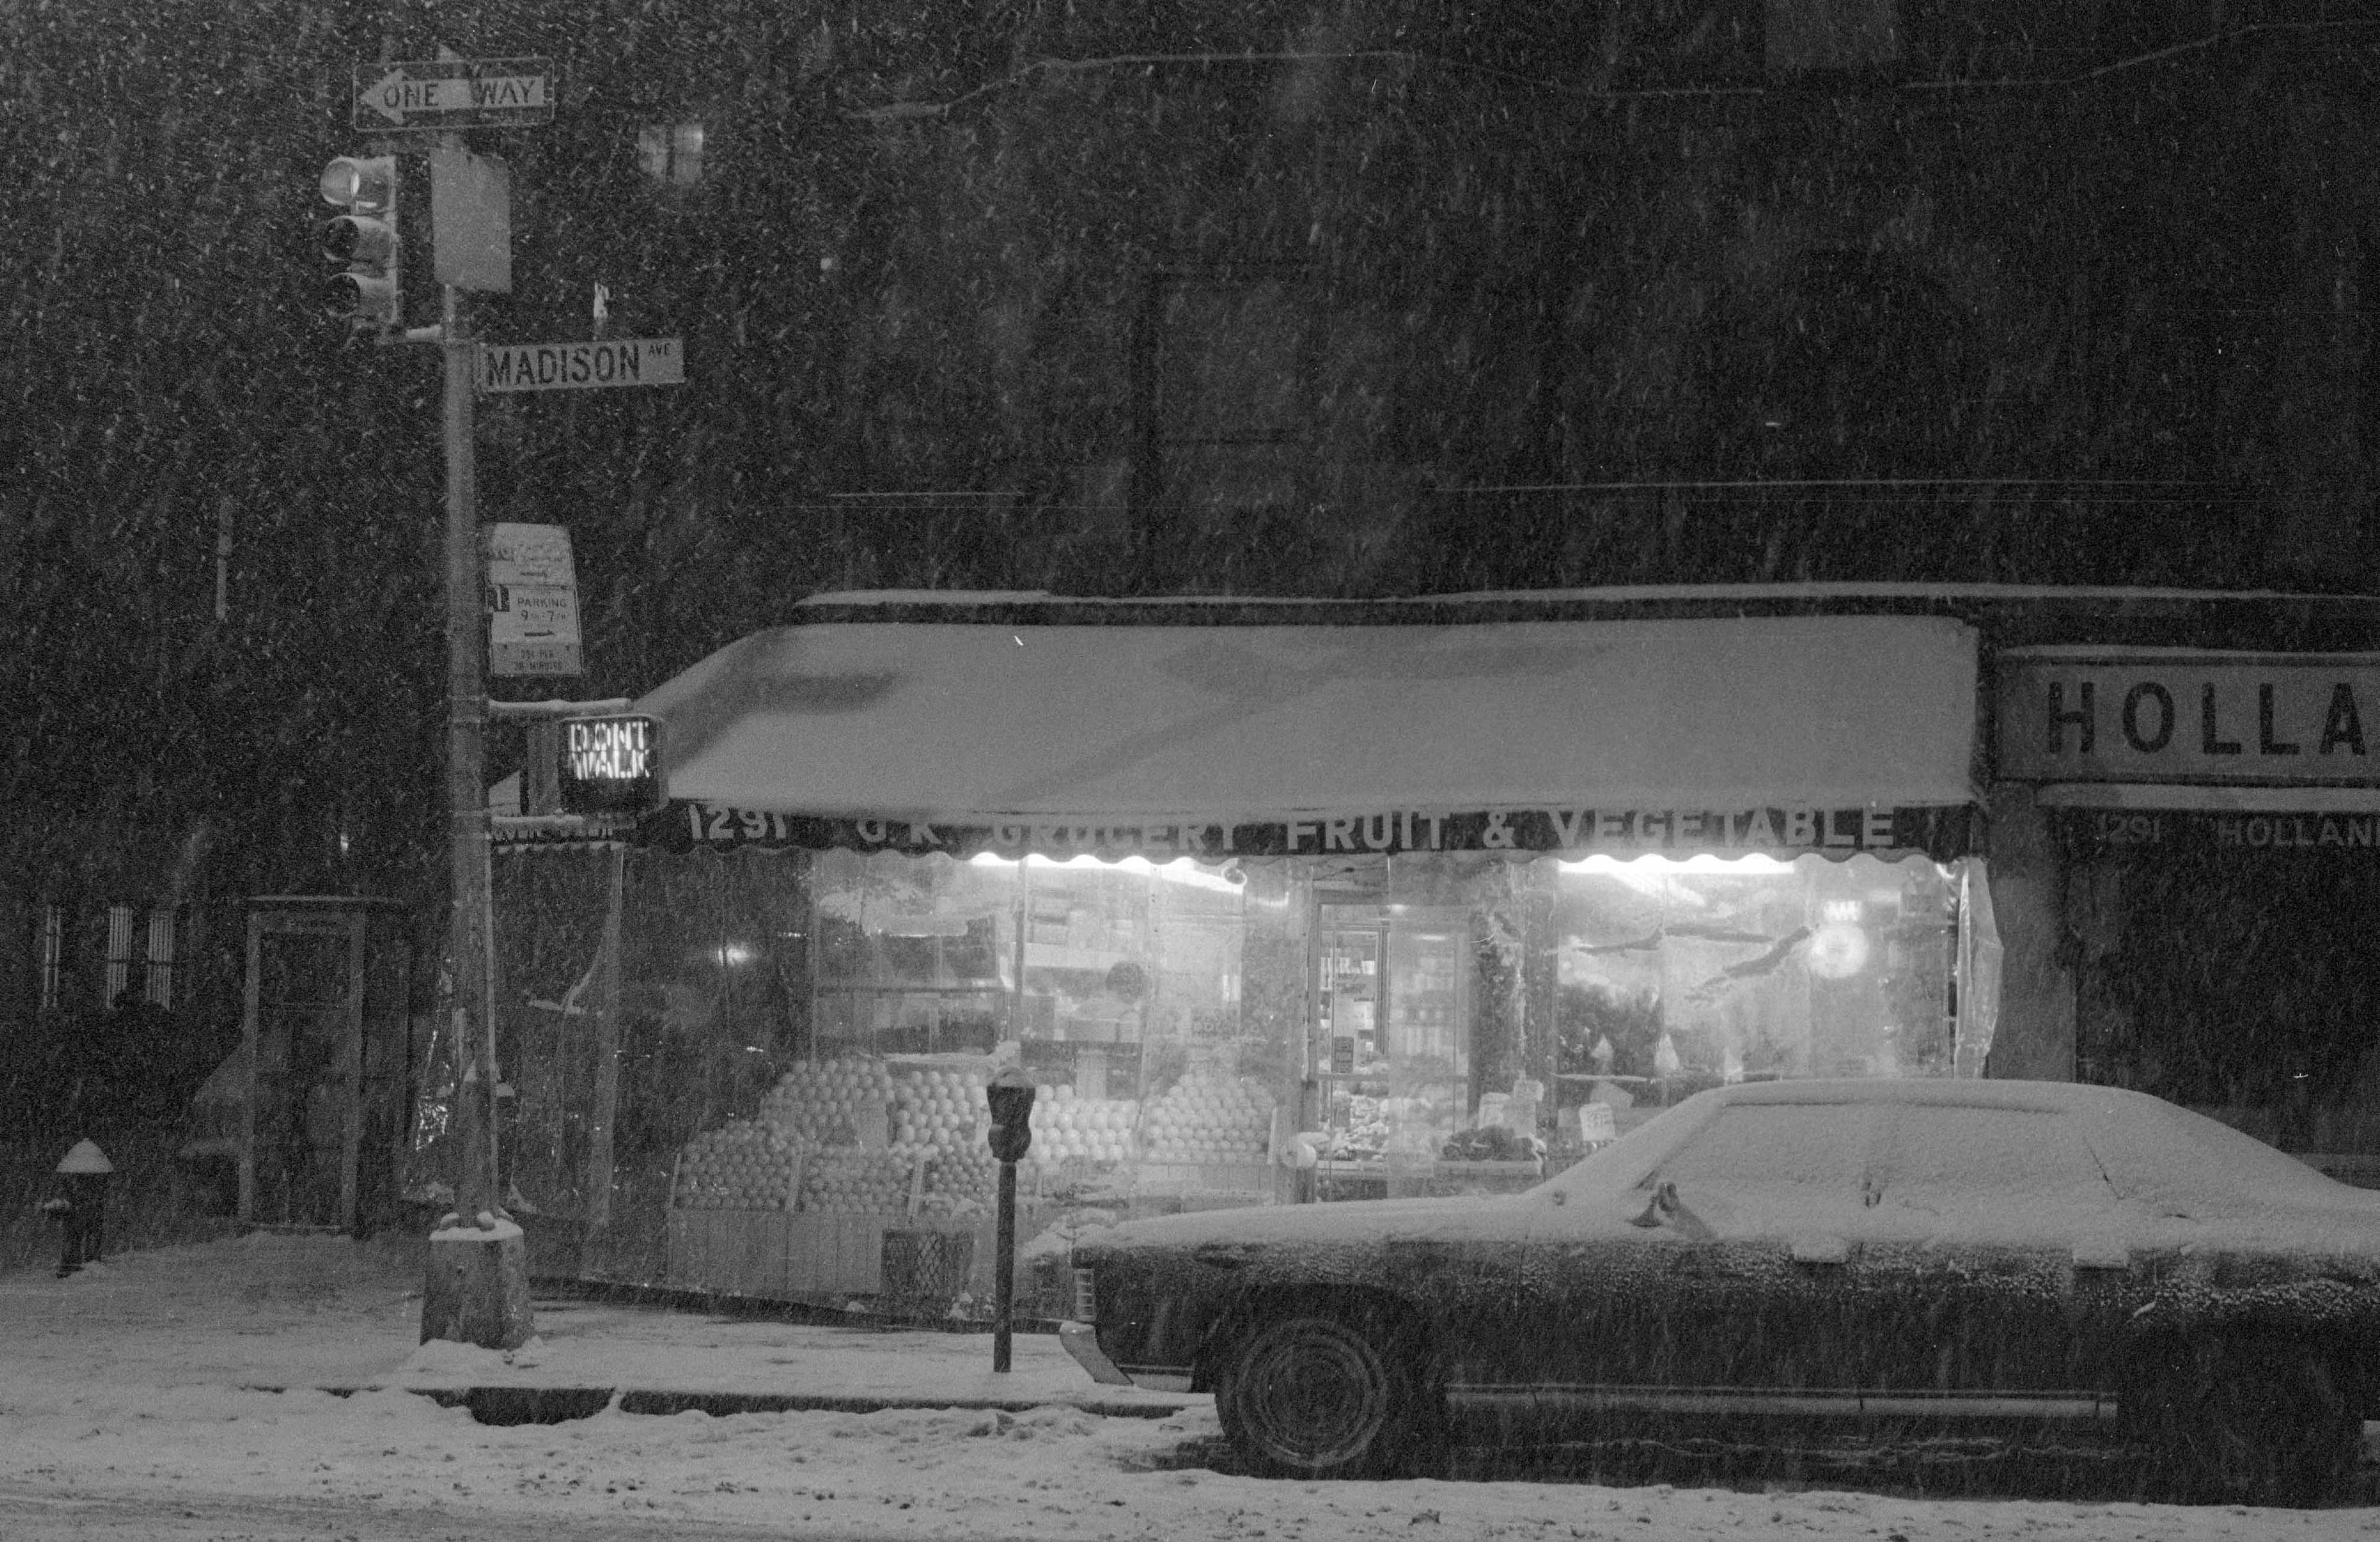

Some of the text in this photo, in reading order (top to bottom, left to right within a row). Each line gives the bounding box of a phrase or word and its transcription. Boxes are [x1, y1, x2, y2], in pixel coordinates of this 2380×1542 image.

[383, 79, 537, 108] ONE WAY
[486, 342, 671, 387] MADISON AVE
[517, 597, 567, 609] PARKING
[2048, 682, 2366, 756] HOLLA
[570, 721, 649, 751] DONT
[570, 749, 650, 780] WALK
[688, 804, 787, 840] 1291
[1285, 810, 1456, 850] FRUIT
[1485, 809, 1518, 848] &
[1545, 806, 1895, 848] VEGETABLE
[2096, 814, 2380, 847] 1291 HOLLAN
